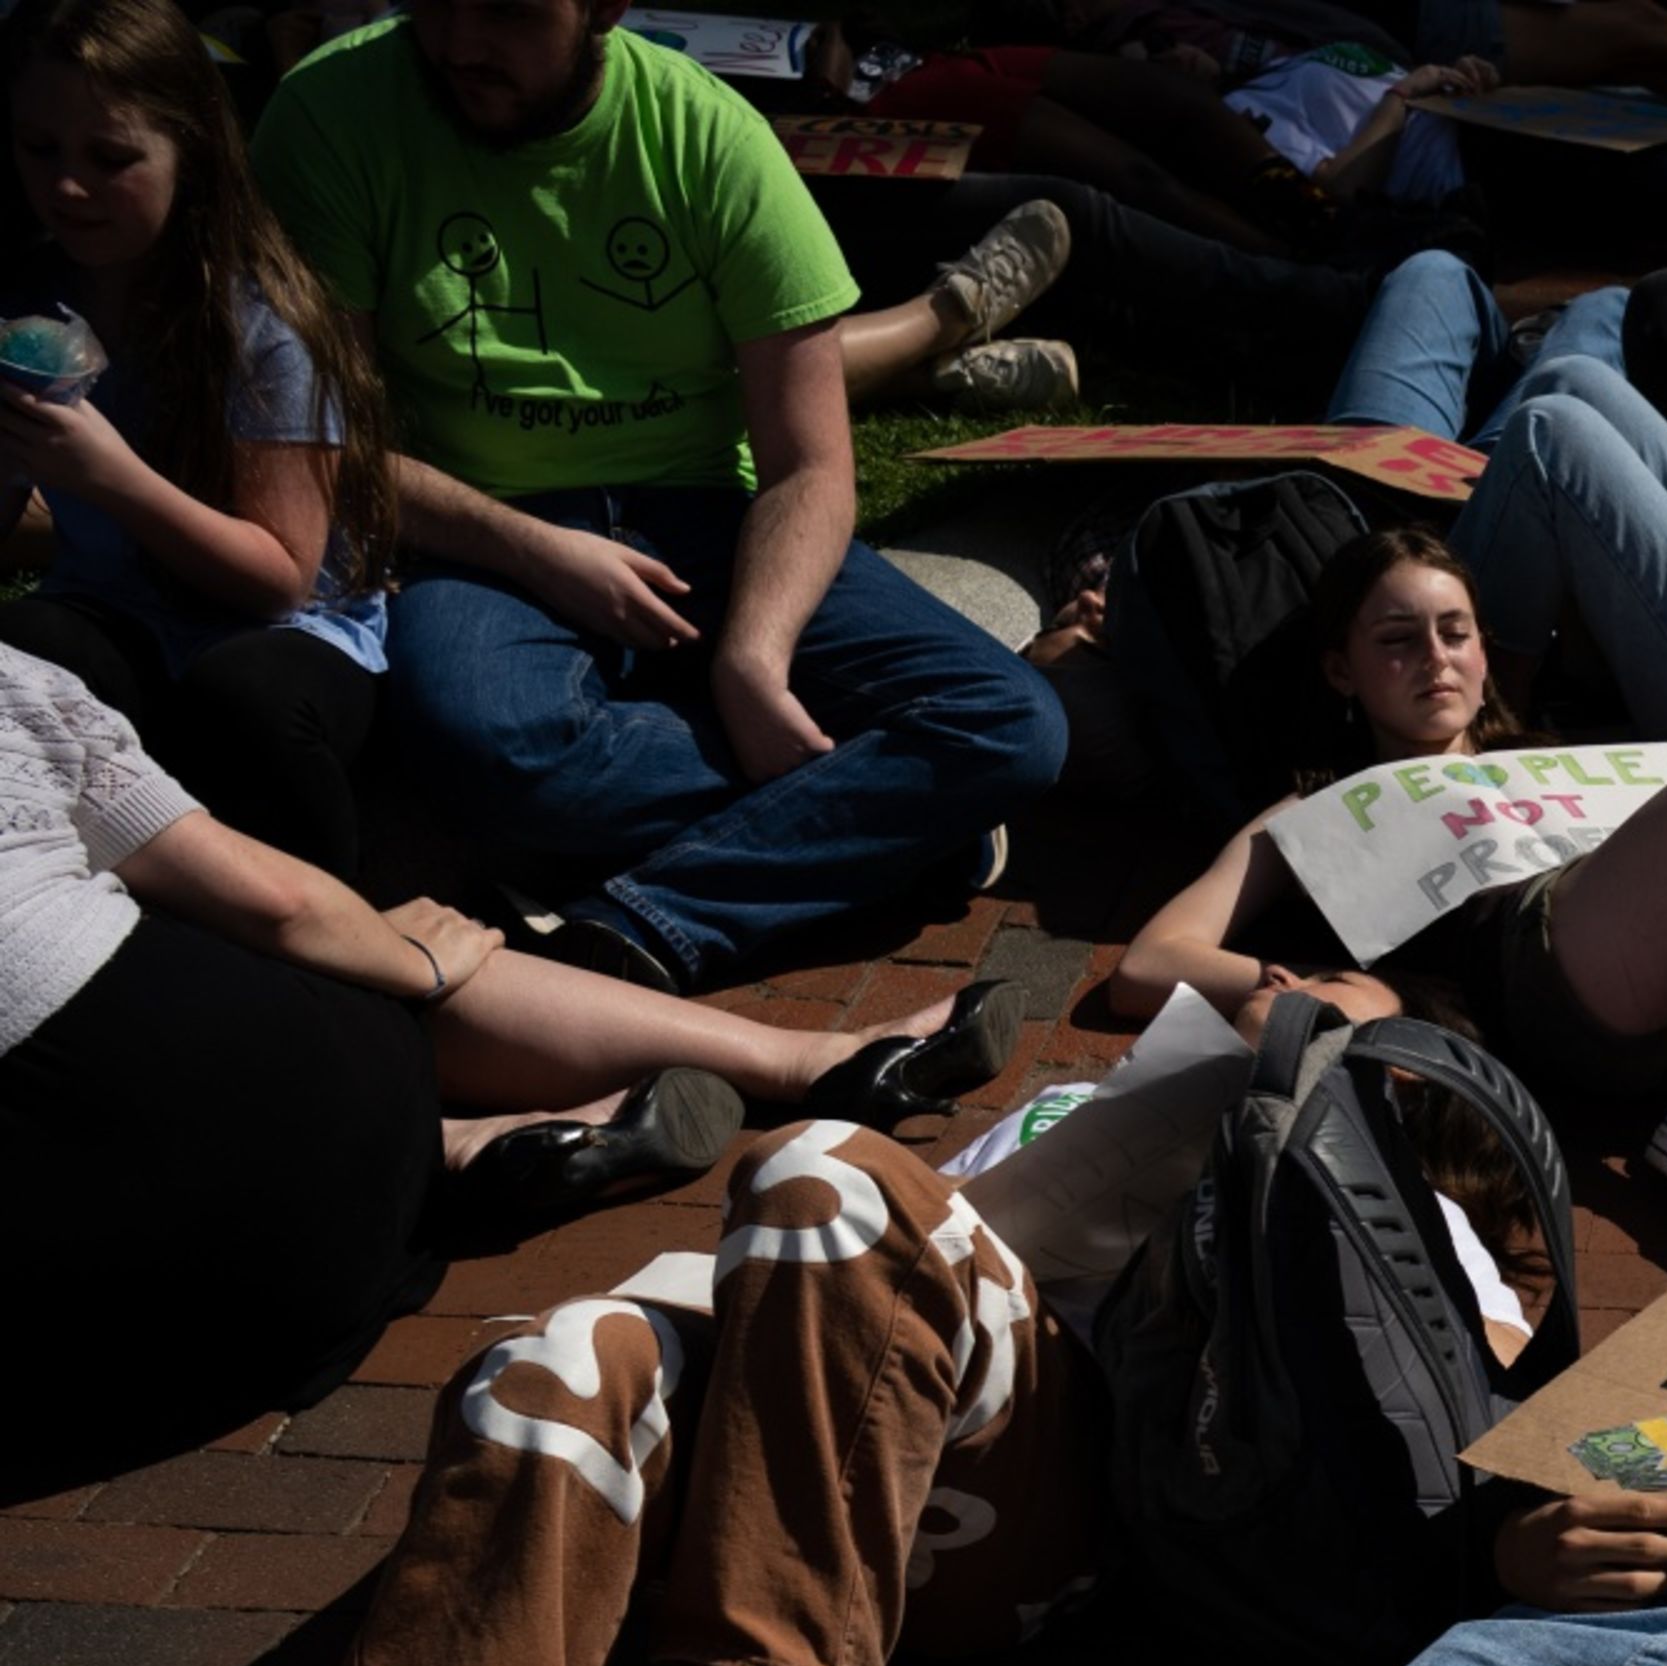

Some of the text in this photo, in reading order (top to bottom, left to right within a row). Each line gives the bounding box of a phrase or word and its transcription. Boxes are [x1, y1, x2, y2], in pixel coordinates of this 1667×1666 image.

[519, 400, 564, 431] got
[568, 400, 624, 435] your
[1341, 750, 1665, 833] PEOPLE
[1441, 793, 1587, 840] NOT
